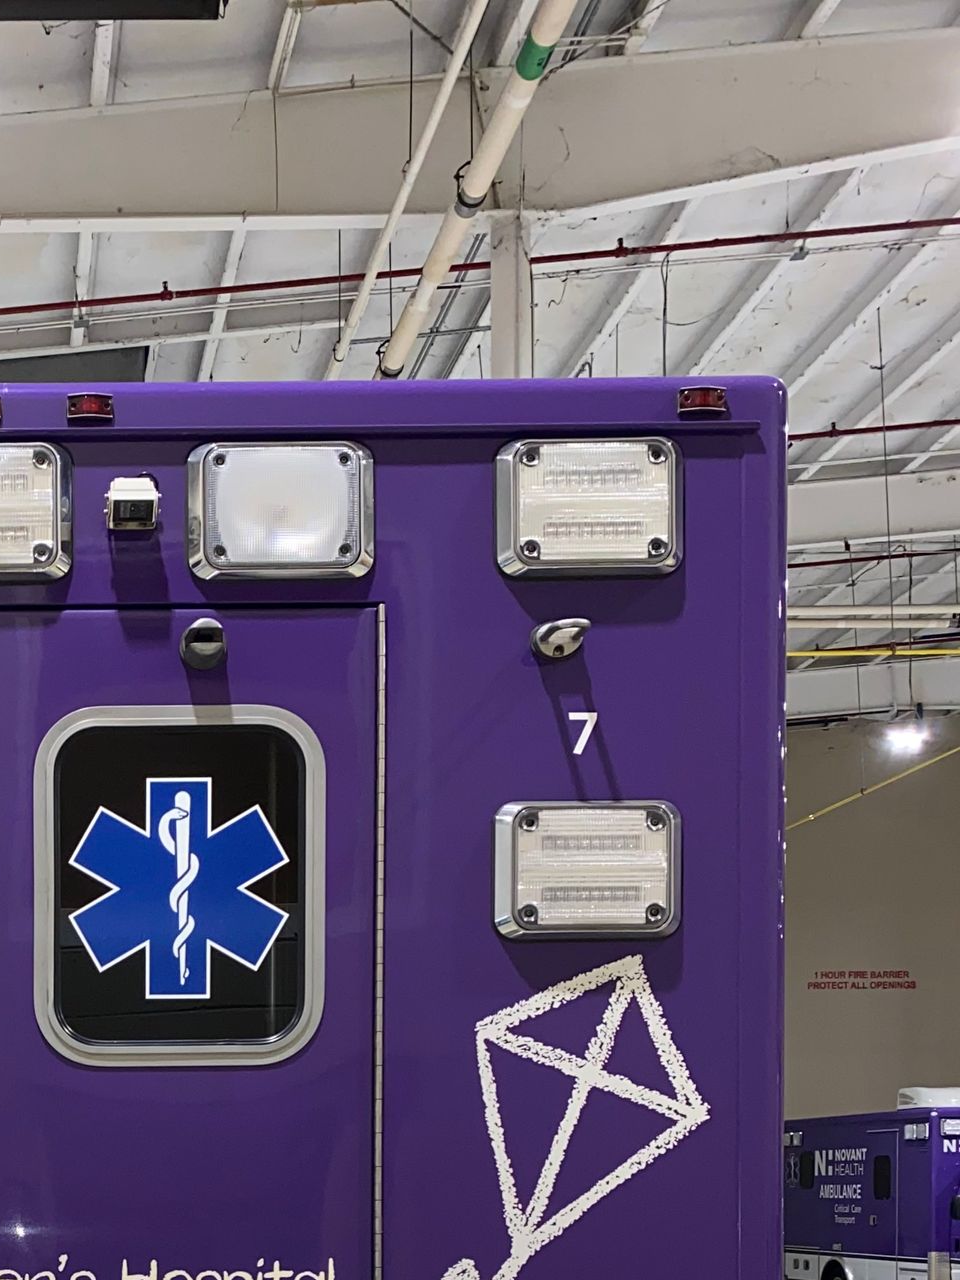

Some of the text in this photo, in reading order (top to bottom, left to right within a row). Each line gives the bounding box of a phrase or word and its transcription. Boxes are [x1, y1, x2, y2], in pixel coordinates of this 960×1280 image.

[568, 712, 598, 755] 7
[820, 971, 846, 979] HOUR
[848, 971, 868, 979] FIRE
[870, 970, 910, 979] BARRIER
[807, 982, 849, 990] PROTECT
[869, 981, 917, 989] OPENINGS
[834, 1148, 868, 1162] NOVANT
[834, 1163, 864, 1176] HEALTH
[819, 1184, 862, 1199] AMBULANCE
